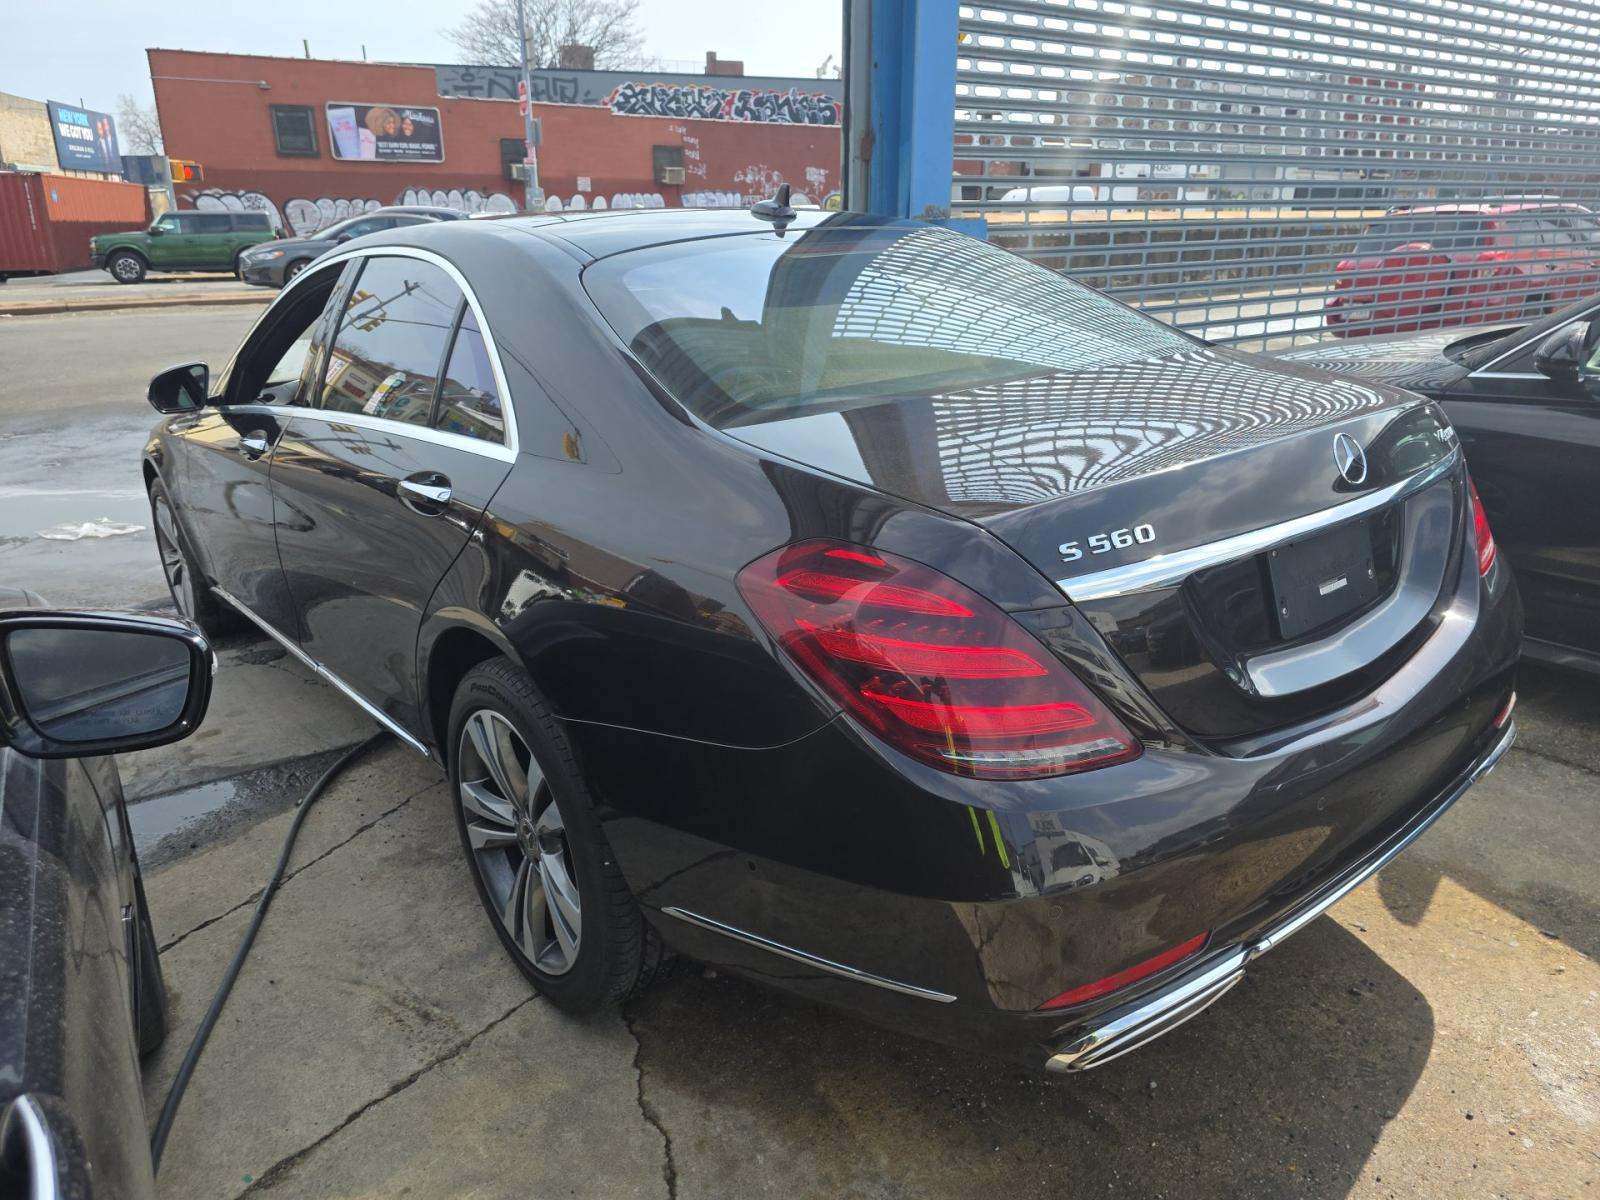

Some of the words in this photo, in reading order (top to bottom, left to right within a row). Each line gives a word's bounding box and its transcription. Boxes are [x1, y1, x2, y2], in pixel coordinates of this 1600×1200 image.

[58, 109, 73, 123] NEW
[73, 112, 89, 127] YORK
[58, 123, 71, 137] WE
[70, 125, 82, 139] GOT
[82, 128, 93, 141] YOU
[1059, 541, 1083, 563] S
[1088, 523, 1157, 555] 560
